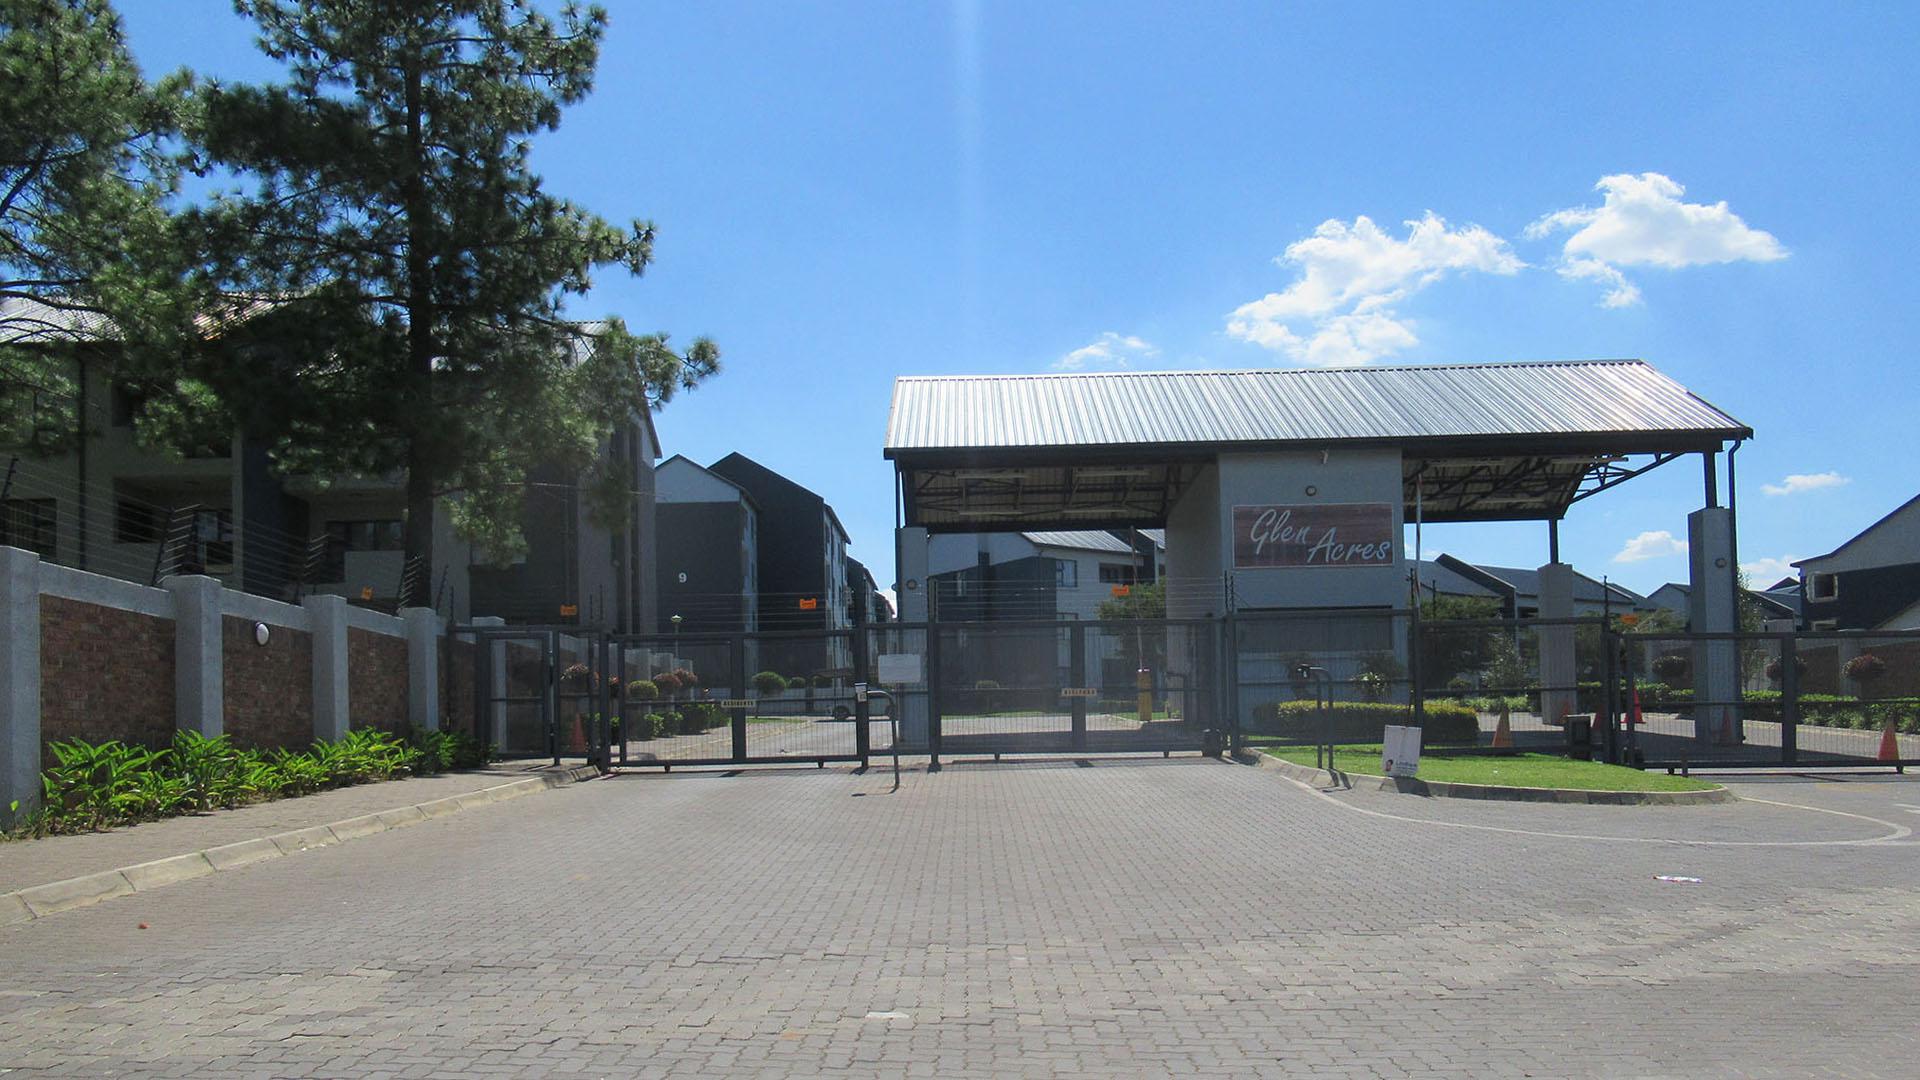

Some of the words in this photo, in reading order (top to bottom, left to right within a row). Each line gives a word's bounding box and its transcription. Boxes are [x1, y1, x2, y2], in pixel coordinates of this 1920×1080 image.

[1250, 508, 1312, 555] Glen
[1307, 527, 1391, 563] Acres
[679, 572, 687, 583] 9
